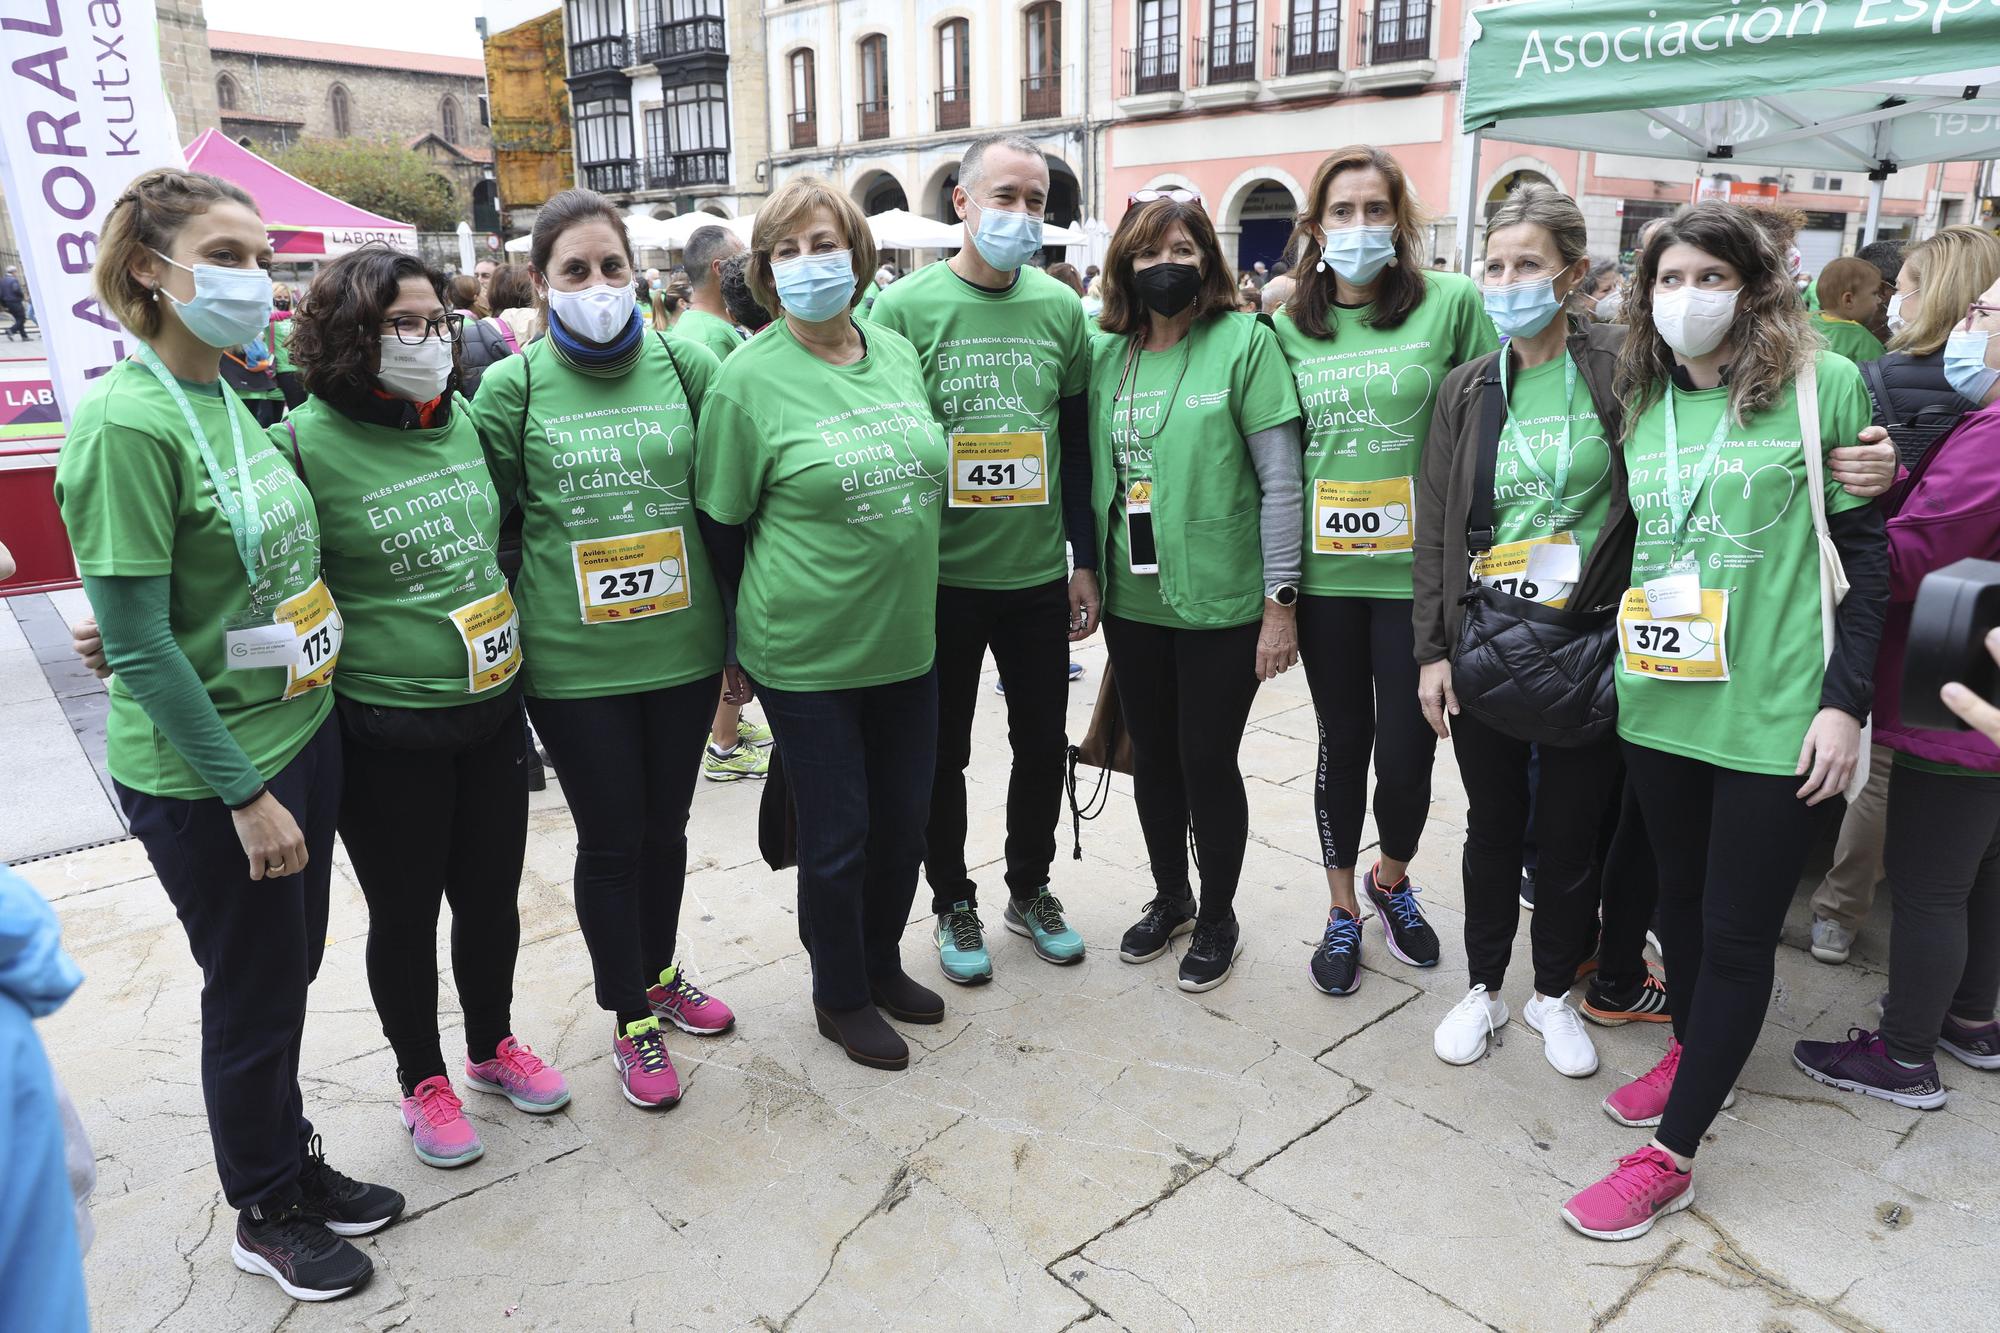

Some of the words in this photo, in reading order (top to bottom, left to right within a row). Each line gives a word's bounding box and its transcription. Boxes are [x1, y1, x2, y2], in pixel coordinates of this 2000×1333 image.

[1515, 0, 1824, 79] Asociación
[1853, 0, 2000, 35] Esp
[332, 231, 407, 245] LABORAL
[937, 353, 961, 371] En
[966, 348, 1033, 367] marcha
[1327, 352, 1357, 362] MARCHA
[1358, 347, 1388, 357] CONTRA
[1400, 341, 1431, 351] CÁNCER
[940, 371, 1000, 393] contra
[1297, 372, 1313, 389] En
[1318, 359, 1390, 383] marcha
[943, 395, 958, 415] el
[962, 393, 1023, 412] cáncer
[1149, 389, 1167, 397] CONT
[1301, 384, 1350, 410] contra
[573, 413, 584, 421] EN
[585, 408, 620, 419] MARCHA
[622, 404, 654, 414] CONTRA
[666, 402, 688, 411] CÁNCE
[816, 415, 841, 429] AVILÉS
[841, 411, 852, 420] EN
[852, 405, 881, 416] MARCHA
[1306, 412, 1317, 430] el
[1317, 408, 1376, 428] cáncer
[1533, 415, 1566, 424] CONTRA
[545, 427, 573, 446] En
[579, 417, 661, 442] marcha
[820, 431, 850, 448] En
[852, 413, 919, 441] marcha
[552, 446, 622, 470] contra
[834, 442, 894, 468] contra
[1677, 444, 1705, 456] ARCHA
[558, 472, 575, 494] el
[579, 468, 651, 490] cáncer
[841, 470, 860, 492] el
[863, 460, 922, 487] cáncer
[968, 464, 1015, 486] 431
[1630, 467, 1649, 487] En
[362, 488, 392, 503] AVILÉS
[393, 483, 406, 492] EN
[406, 471, 440, 487] MARCHA
[367, 506, 403, 530] En
[406, 478, 479, 516] marcha
[571, 505, 586, 516] edp
[857, 502, 871, 513] edp
[563, 517, 599, 528] fundación
[608, 513, 635, 521] LABORAL
[847, 512, 884, 524] fundación
[1326, 512, 1380, 533] 400
[380, 516, 455, 554] contra
[390, 553, 411, 575] el
[417, 532, 483, 568] cáncer
[584, 558, 609, 566] contra
[619, 552, 645, 561] cáncer
[607, 547, 618, 555] en
[1503, 549, 1528, 559] march
[1504, 558, 1527, 566] cánce
[1637, 552, 1649, 561] edp
[599, 568, 655, 600] 237
[468, 620, 486, 632] contra
[302, 626, 332, 666] 173
[483, 626, 512, 663] 541
[1634, 625, 1680, 653] 372
